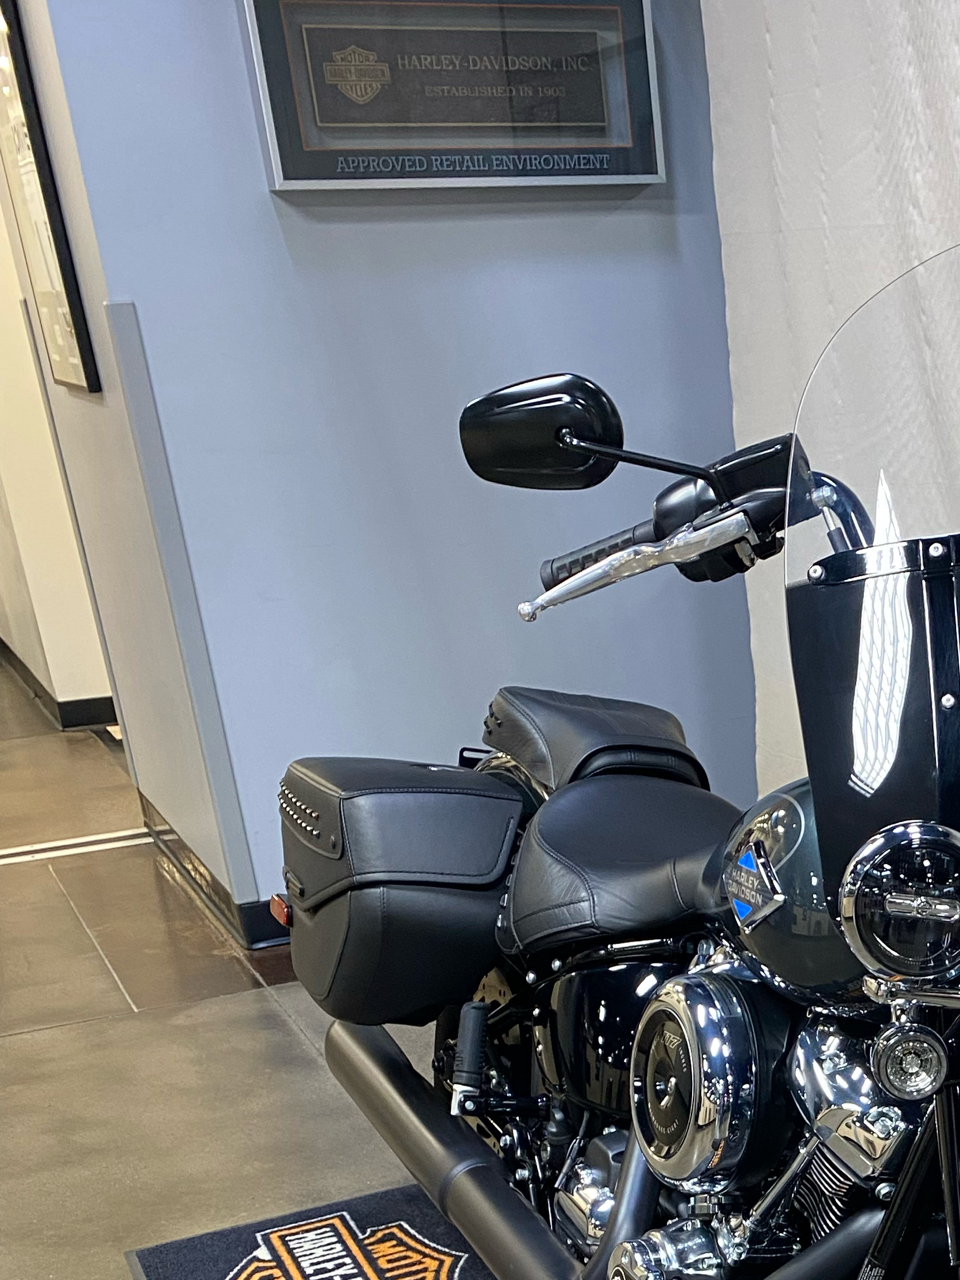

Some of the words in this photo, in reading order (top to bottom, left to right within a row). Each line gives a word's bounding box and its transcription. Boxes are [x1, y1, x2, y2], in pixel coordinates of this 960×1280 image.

[397, 55, 558, 73] HARLEY-DAVIDSON,
[424, 85, 516, 97] ESTABLISHED
[519, 86, 534, 97] IN
[336, 156, 428, 172] APPROVED
[431, 155, 489, 171] RETAIL
[491, 154, 610, 170] ENVIRONMENT
[727, 880, 763, 906] DAVIDSON
